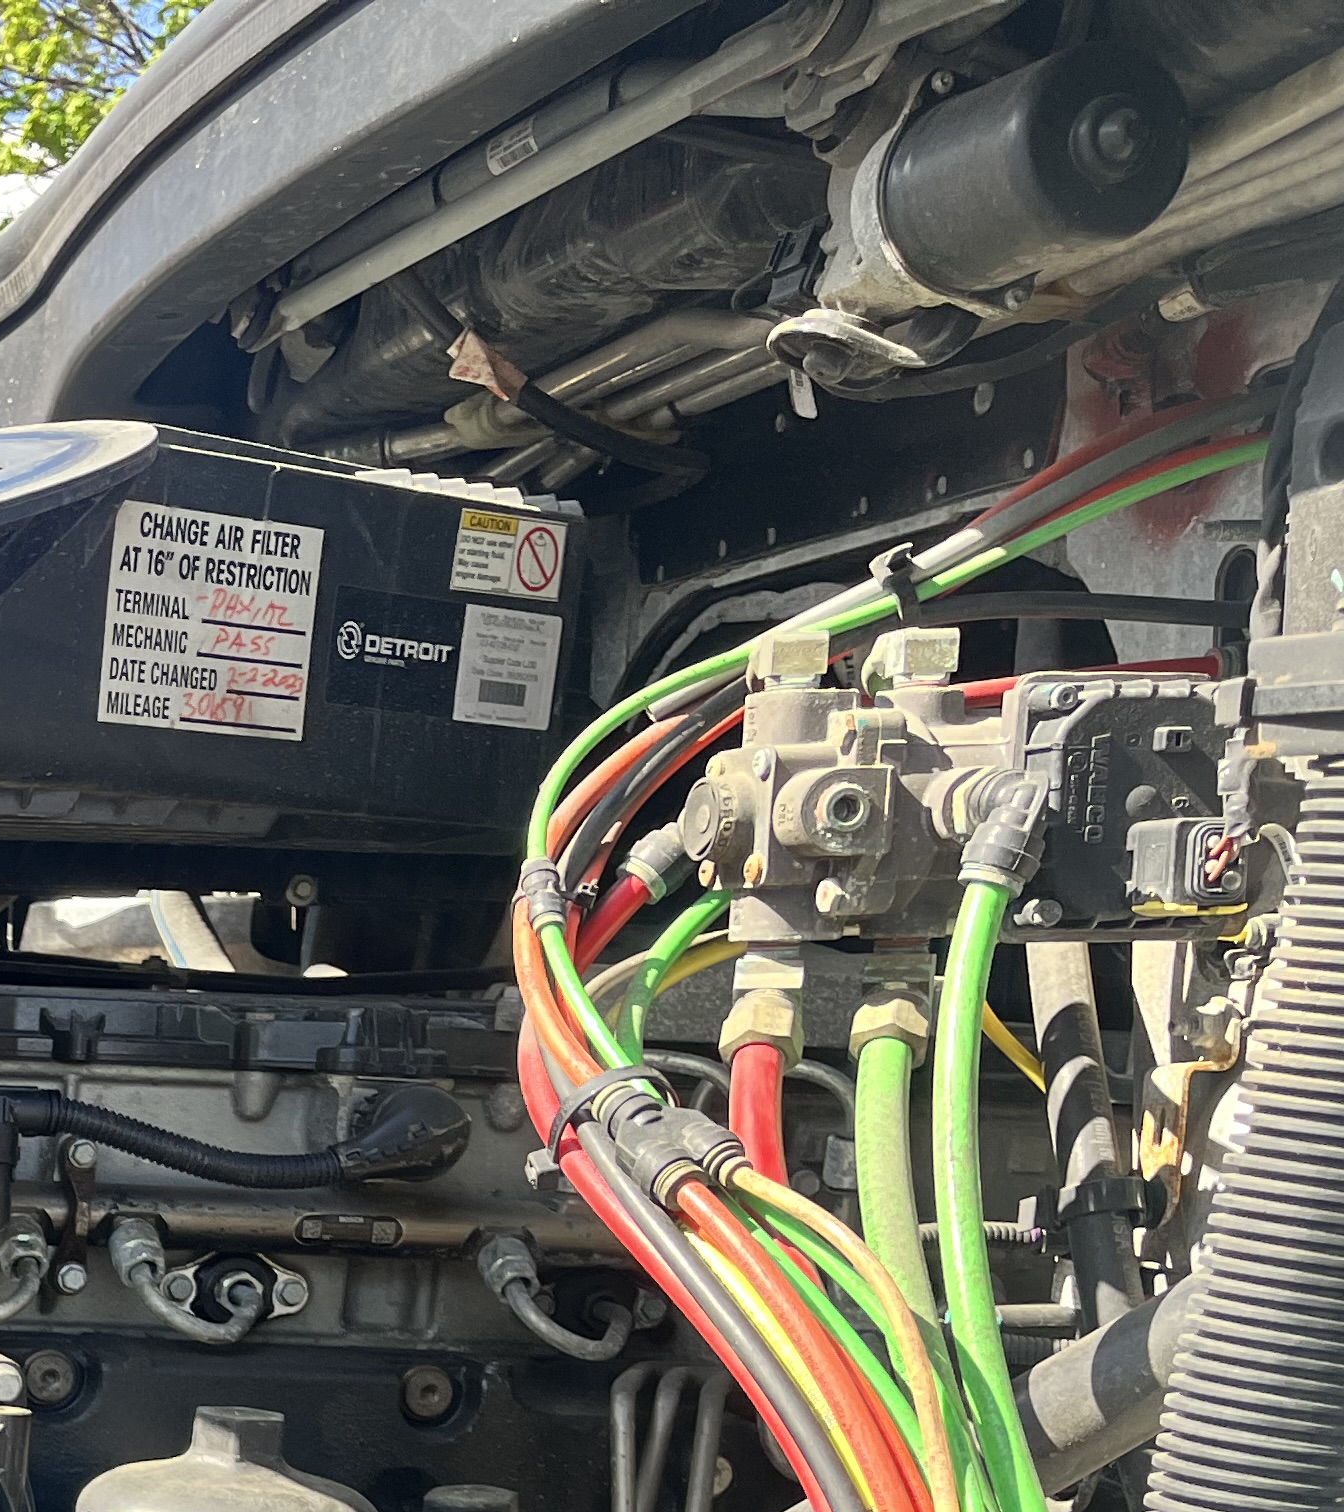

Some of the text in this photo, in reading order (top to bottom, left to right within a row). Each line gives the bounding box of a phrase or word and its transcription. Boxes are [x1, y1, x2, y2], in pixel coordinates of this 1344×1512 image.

[140, 511, 301, 560] CHANGE AIR FILTER
[469, 515, 511, 532] CAUTION
[119, 545, 142, 573] AT
[178, 553, 201, 581] OF
[205, 557, 312, 596] RESTRICTION
[115, 588, 190, 620] TERMINAL
[111, 623, 189, 654] MECHANIC
[364, 633, 455, 663] DETROIT
[109, 657, 218, 692] DATE CHANGED
[106, 691, 171, 720] MILEAGE
